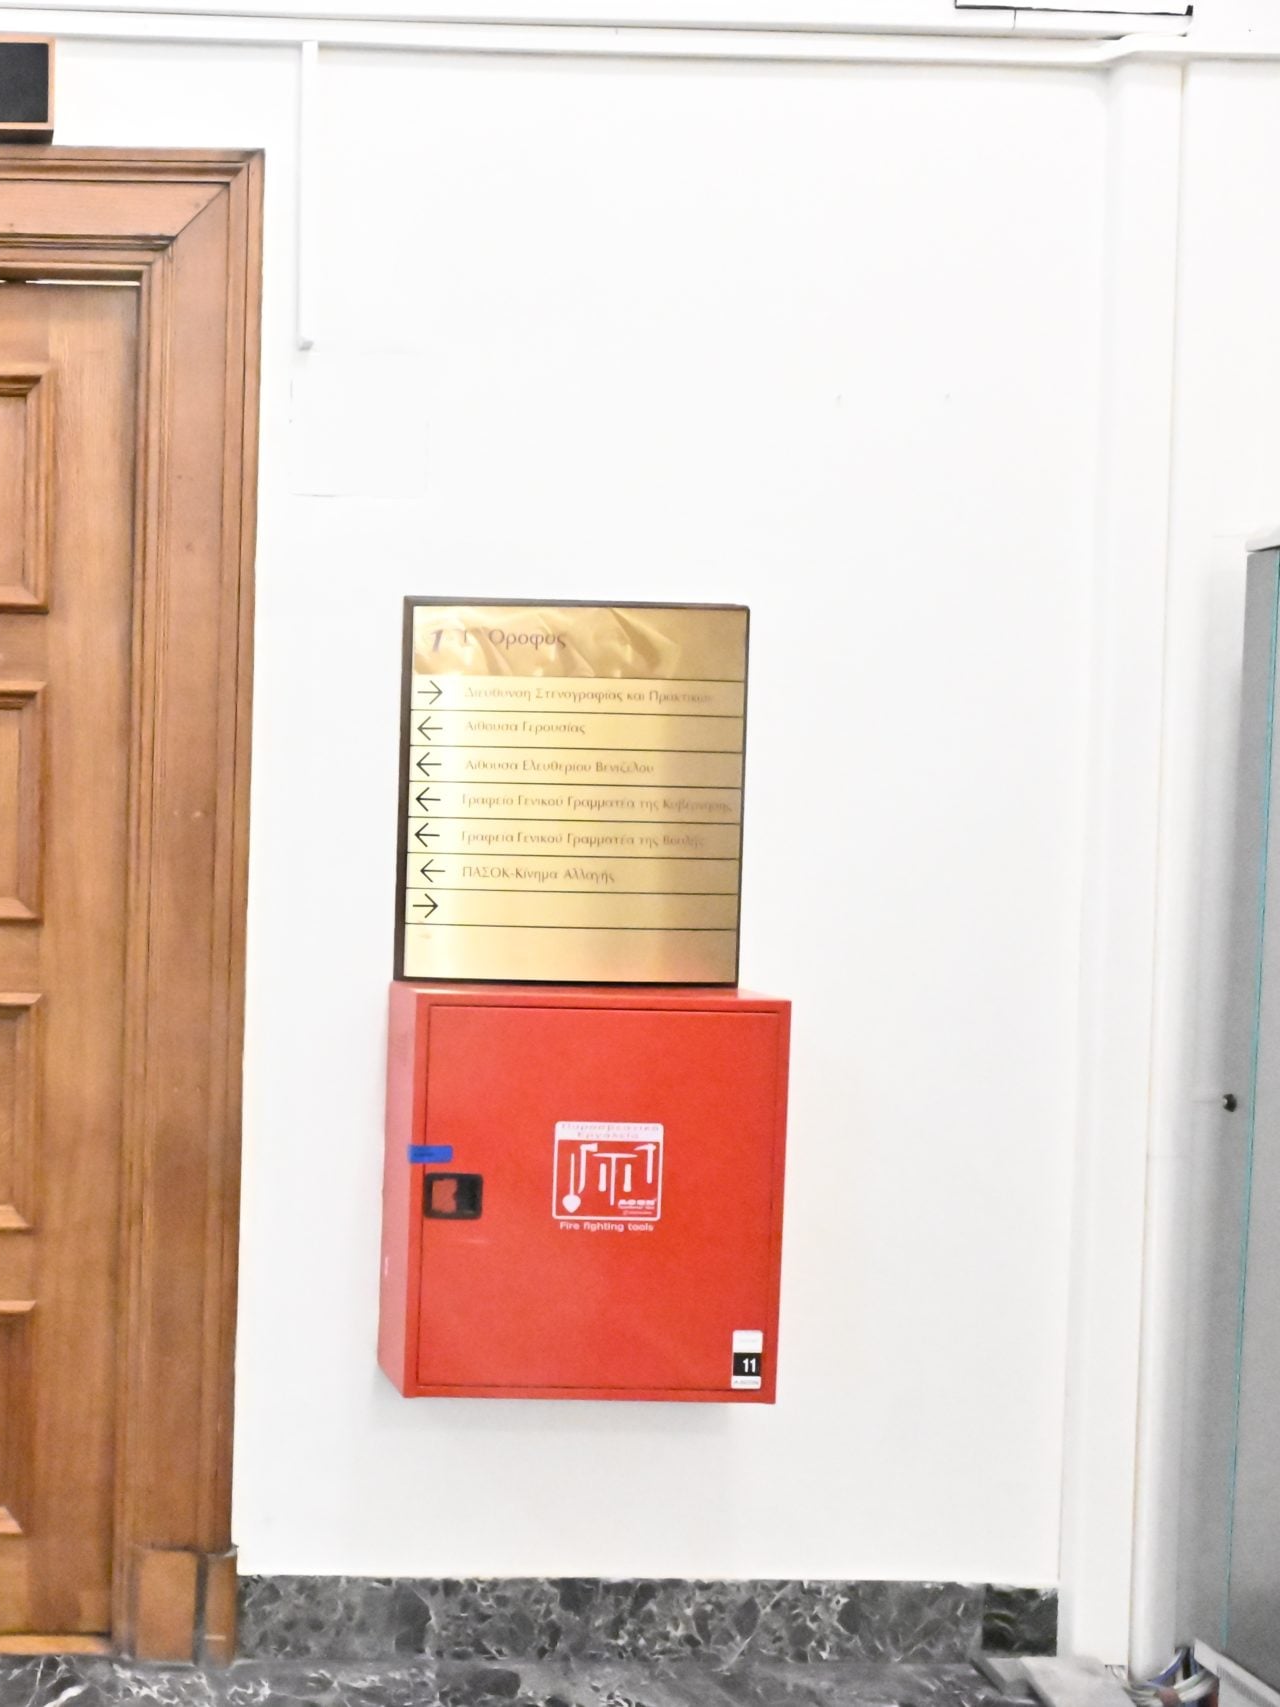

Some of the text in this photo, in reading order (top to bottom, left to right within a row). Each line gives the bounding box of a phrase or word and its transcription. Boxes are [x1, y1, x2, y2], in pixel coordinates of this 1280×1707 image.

[626, 691, 645, 702] και
[559, 1221, 655, 1233] Fire fighting tools
[742, 1357, 757, 1373] 11
